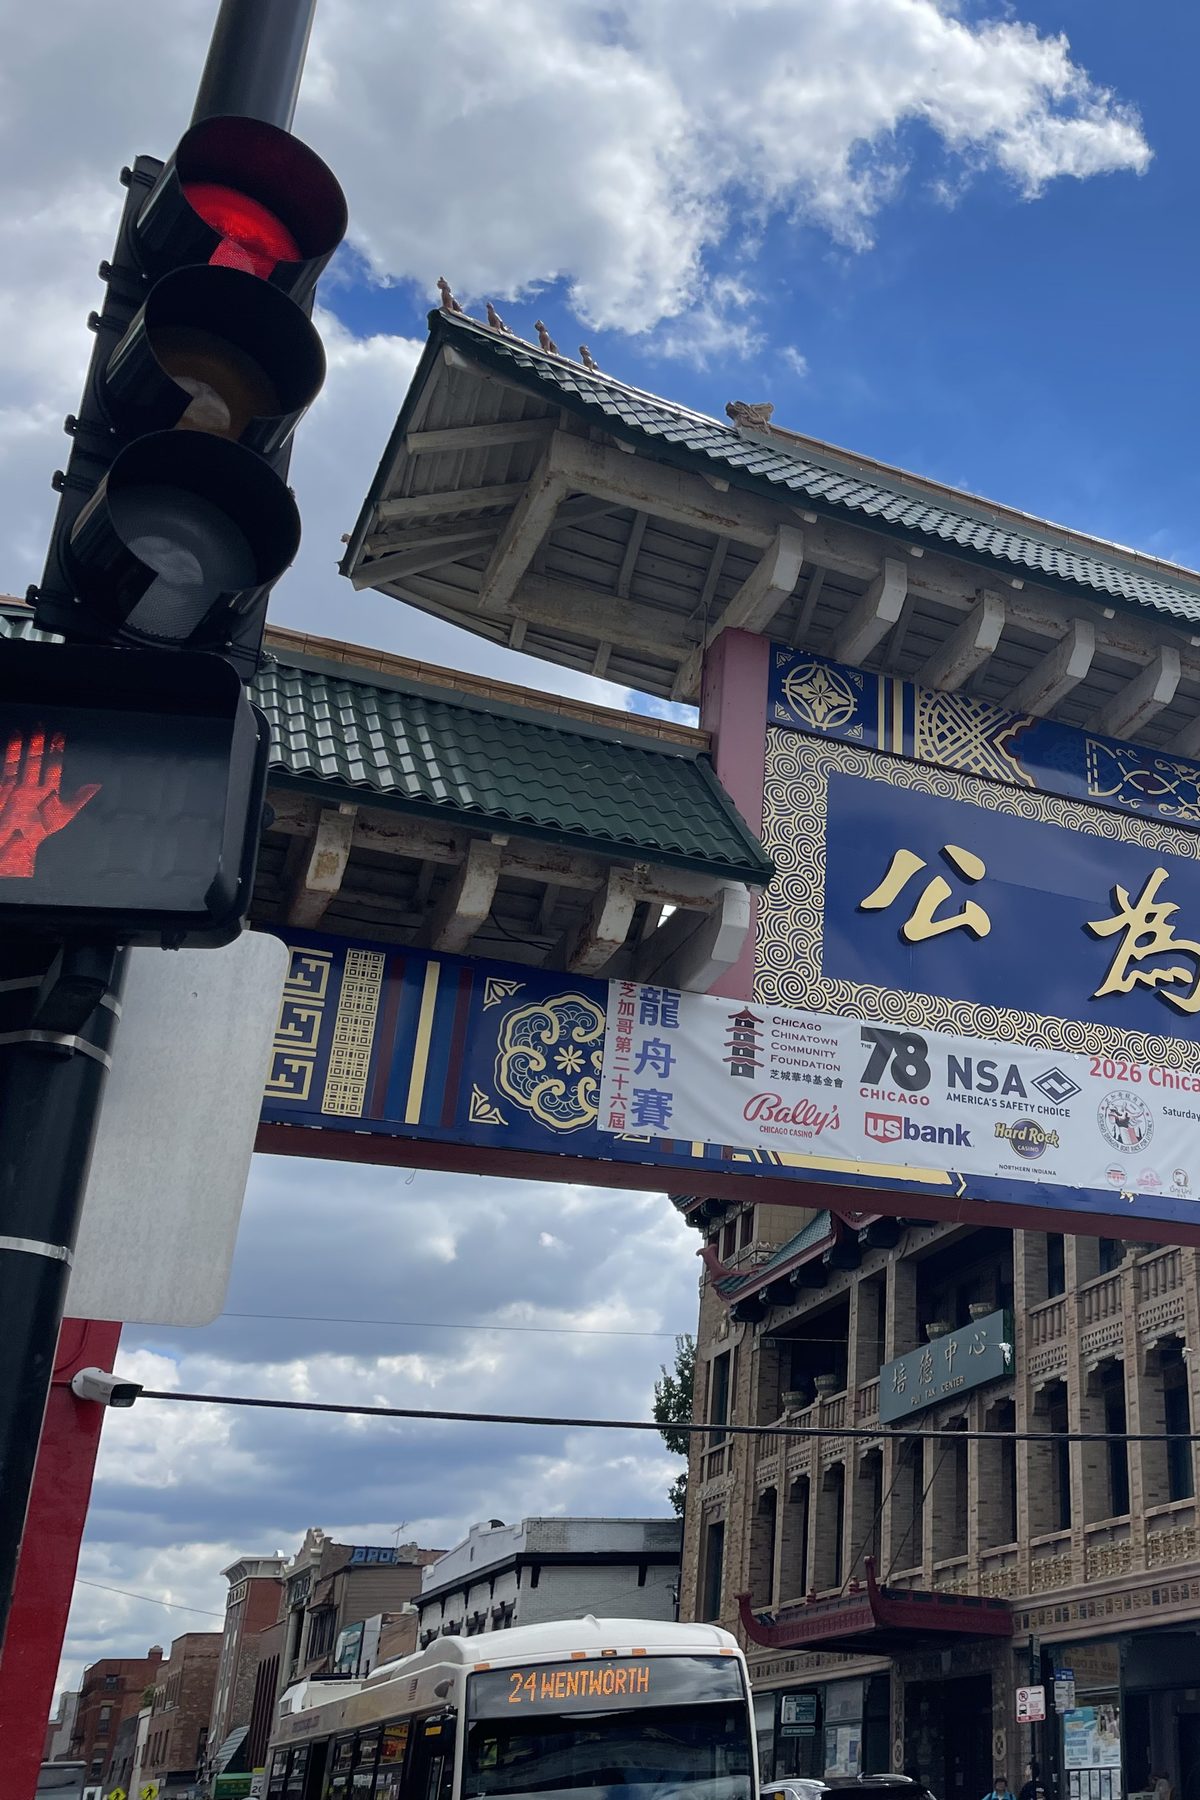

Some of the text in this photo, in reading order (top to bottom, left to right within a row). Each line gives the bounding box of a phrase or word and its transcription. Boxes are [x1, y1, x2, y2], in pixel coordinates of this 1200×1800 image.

[772, 1016, 822, 1031] CHICAGO
[771, 1029, 838, 1046] CHINATOWN
[607, 981, 637, 1130] 芝加哥第二十六屆
[630, 986, 681, 1131] 龍舟賽
[771, 1042, 836, 1058] COMMUNITY
[860, 1026, 931, 1091] 78
[770, 1054, 840, 1072] FOUNDATION
[1089, 1057, 1142, 1083] 2026
[770, 1069, 843, 1088] 芝城華埠基金會
[947, 1054, 1027, 1098] NSA
[859, 1088, 930, 1106] CHICAGO
[946, 1093, 1070, 1118] AMERICA'S SAFETY CHOICE
[743, 1092, 840, 1135] Bally's
[760, 1125, 813, 1138] CHICAGO CASINO
[994, 1122, 1059, 1148] Hard Rock
[1017, 1145, 1039, 1153] CASINO
[999, 1163, 1057, 1176] NORTHERN INDIANA
[891, 1330, 988, 1394] 培德中心
[940, 1375, 965, 1392] CENTER
[508, 1666, 649, 1703] 24 WENTWORTH
